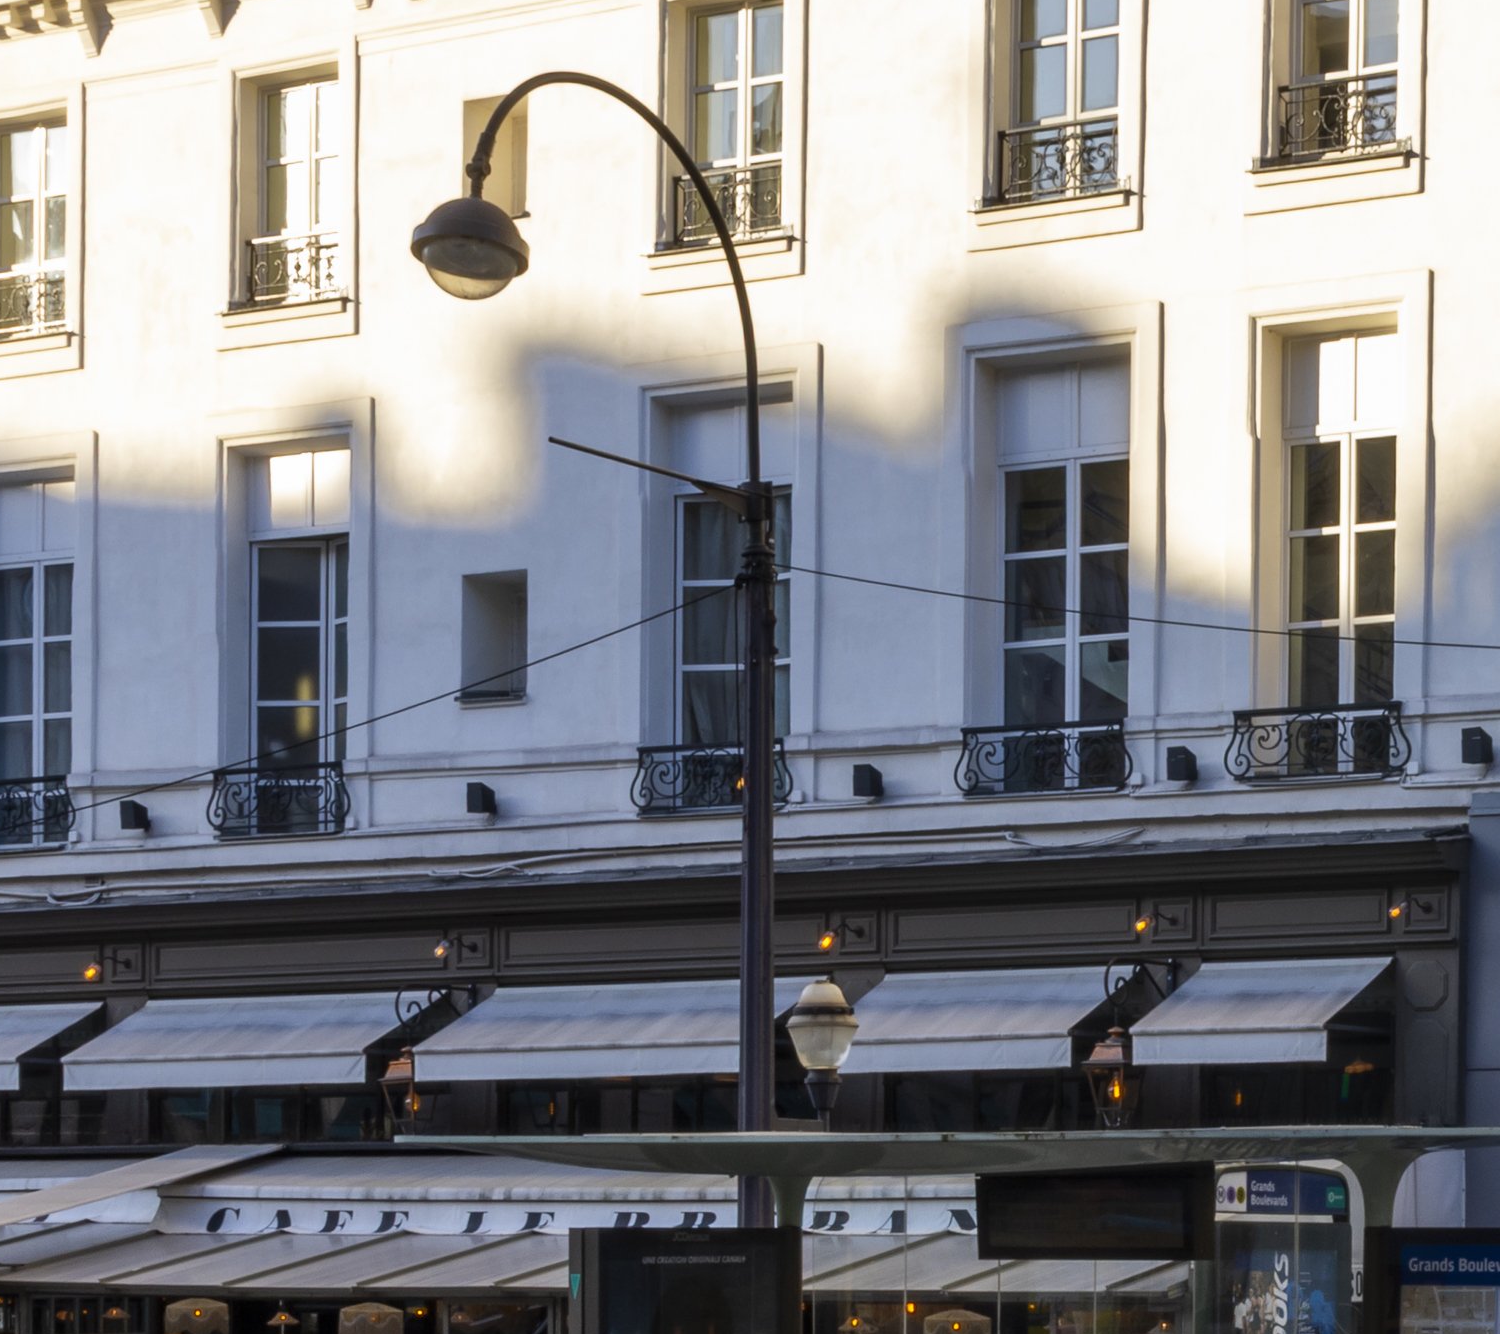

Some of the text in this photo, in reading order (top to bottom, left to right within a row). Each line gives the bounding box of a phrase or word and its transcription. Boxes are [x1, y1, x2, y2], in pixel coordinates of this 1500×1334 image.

[1251, 1180, 1275, 1192] Grands
[1251, 1194, 1288, 1207] Boulevards
[1408, 1258, 1454, 1272] Grands
